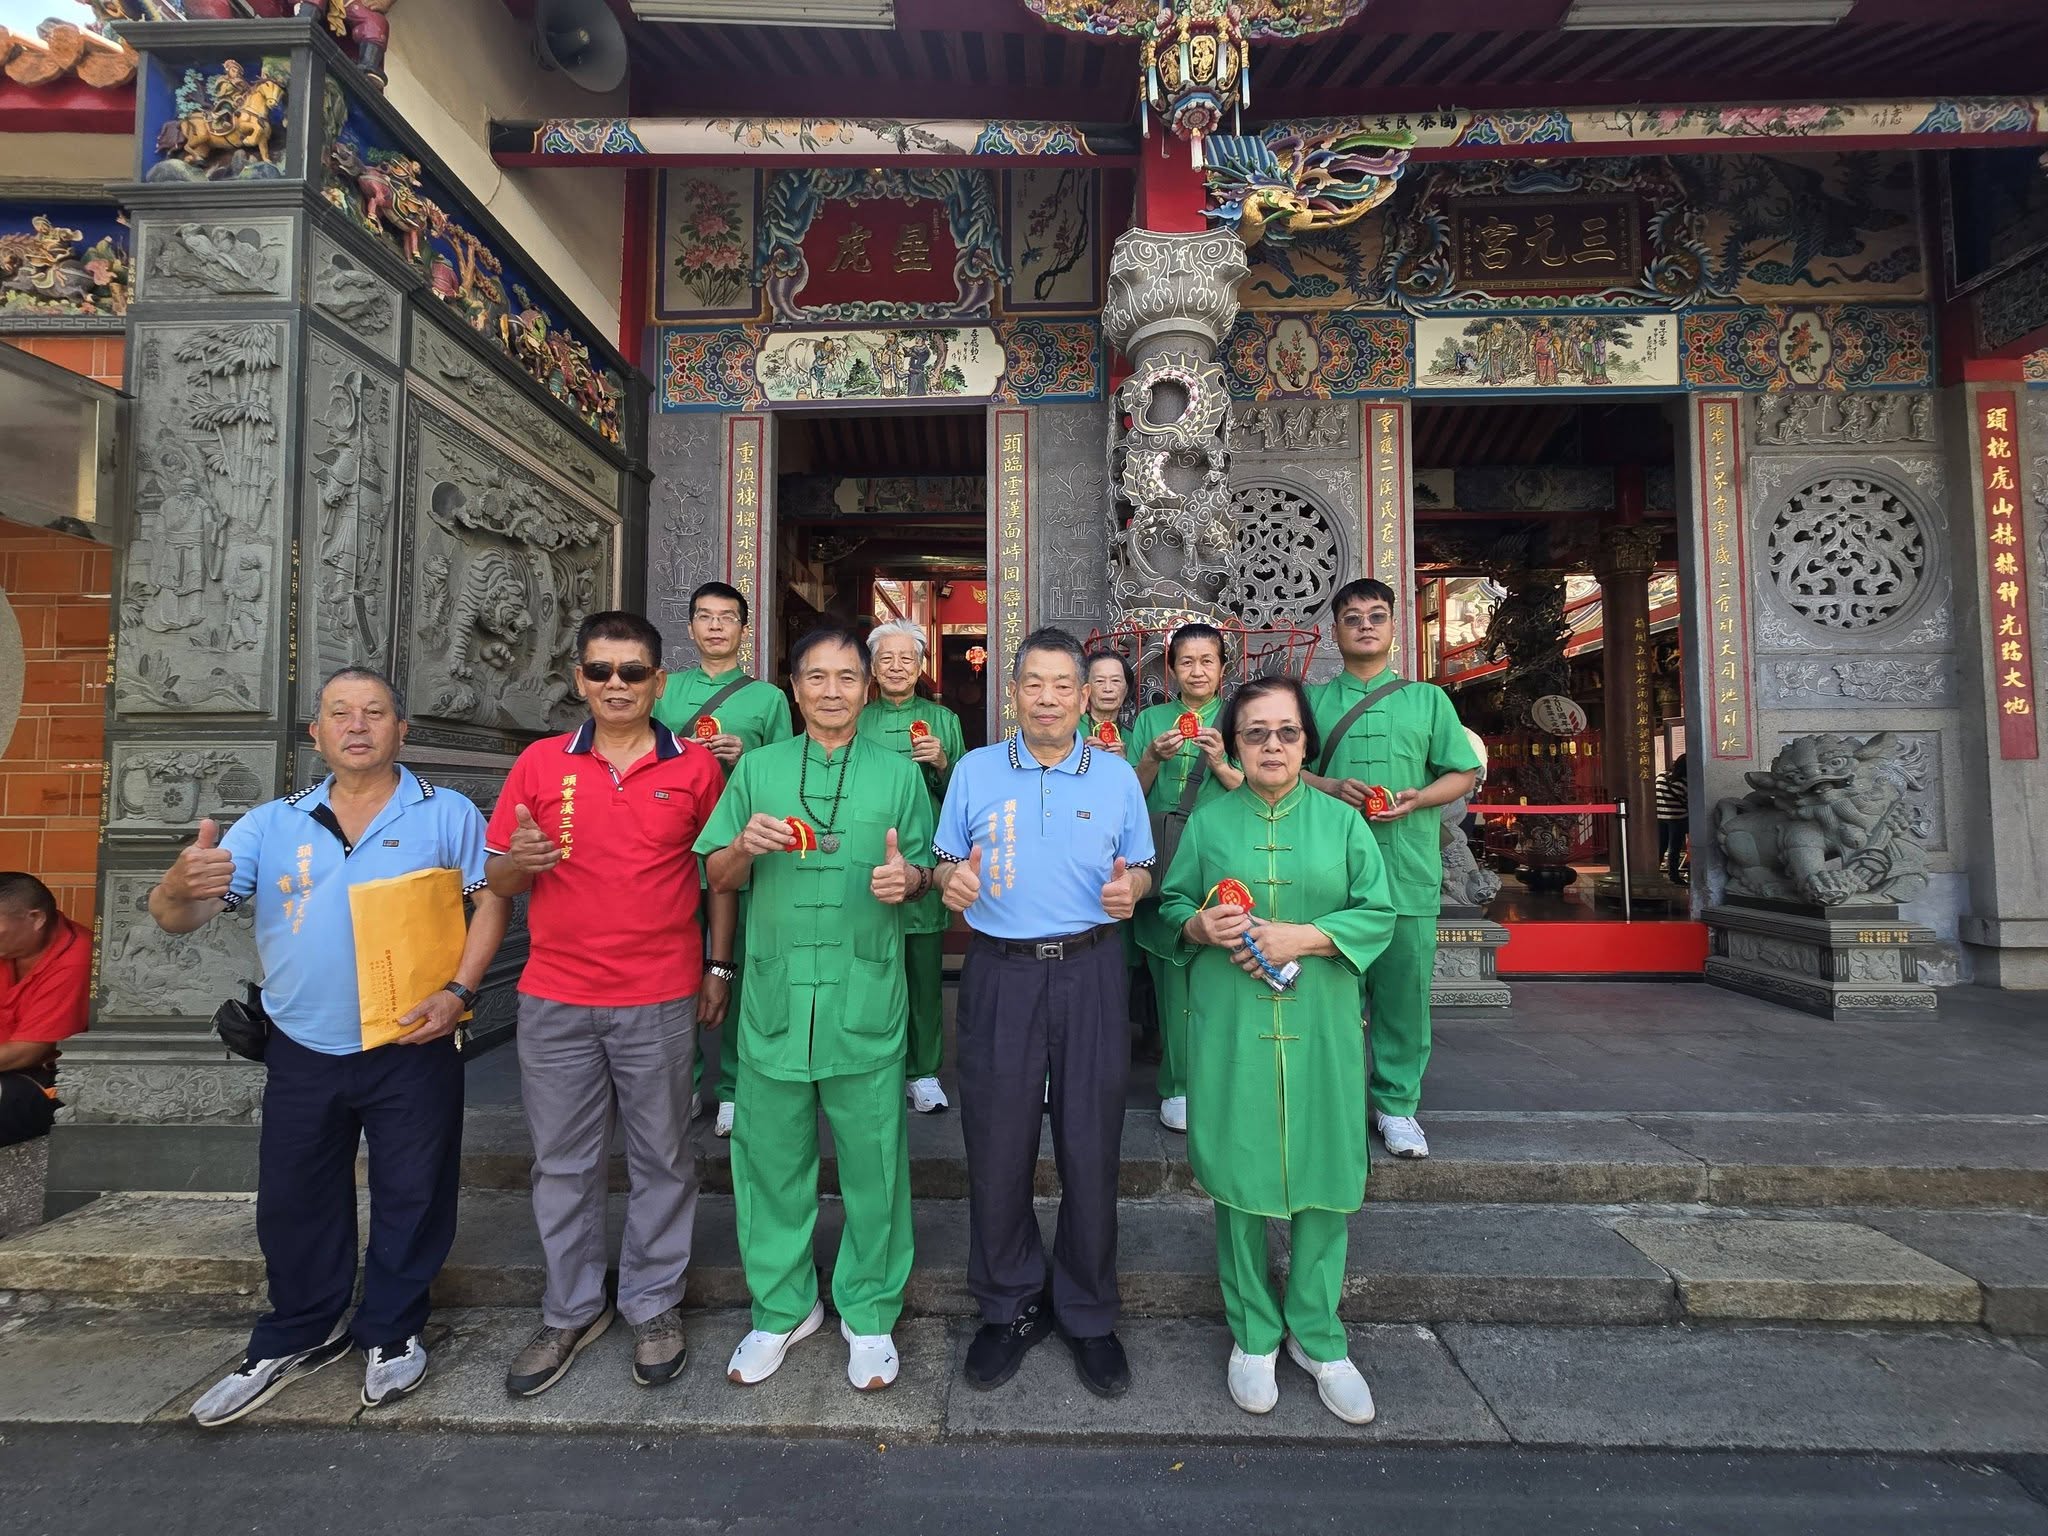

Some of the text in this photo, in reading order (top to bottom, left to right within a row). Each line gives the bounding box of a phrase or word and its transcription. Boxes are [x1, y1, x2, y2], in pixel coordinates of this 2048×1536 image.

[1374, 113, 1458, 132] 國泰民安
[1474, 214, 1617, 270] 三元宮
[559, 774, 577, 860] 頭重溪三元宮
[1003, 798, 1017, 889] 頭重溪三元宮
[292, 843, 314, 935] 頭重溪三元宮
